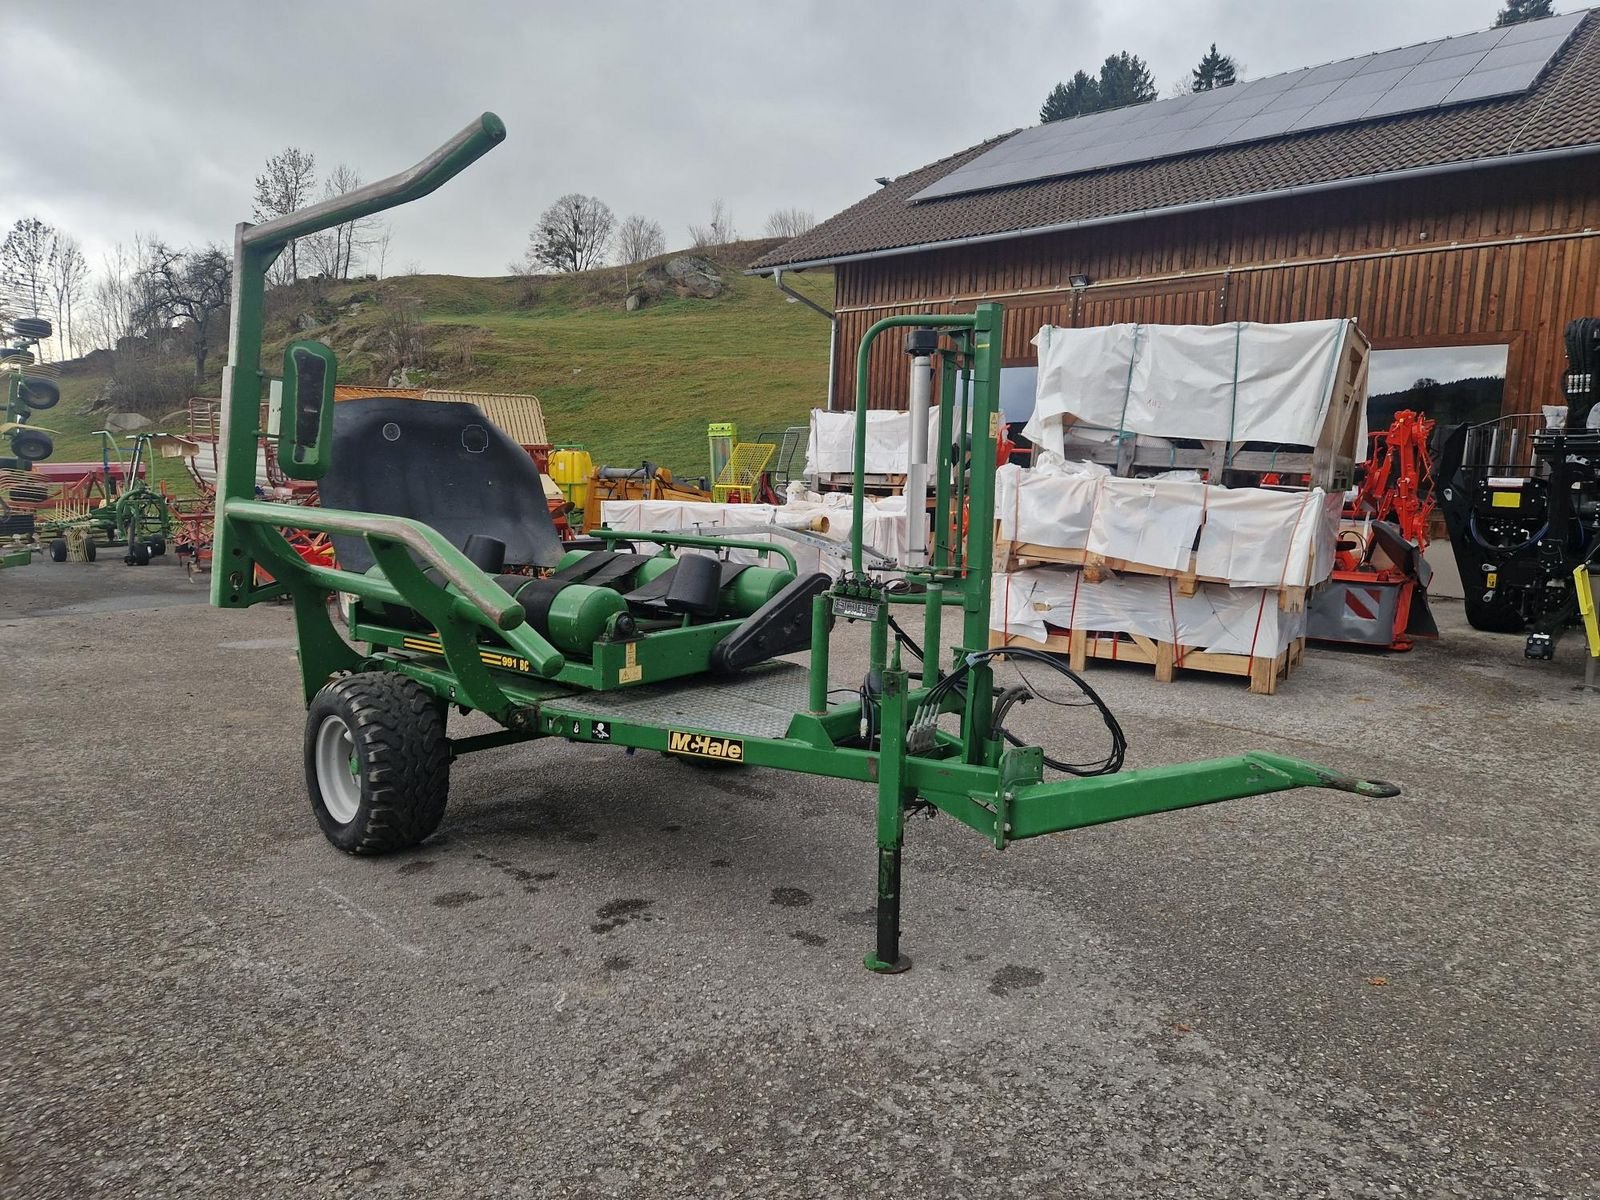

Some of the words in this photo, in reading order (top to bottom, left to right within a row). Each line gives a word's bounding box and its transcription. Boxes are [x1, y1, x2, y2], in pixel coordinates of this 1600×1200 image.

[502, 656, 517, 668] 991
[520, 659, 529, 671] BC
[671, 732, 742, 759] McHale
